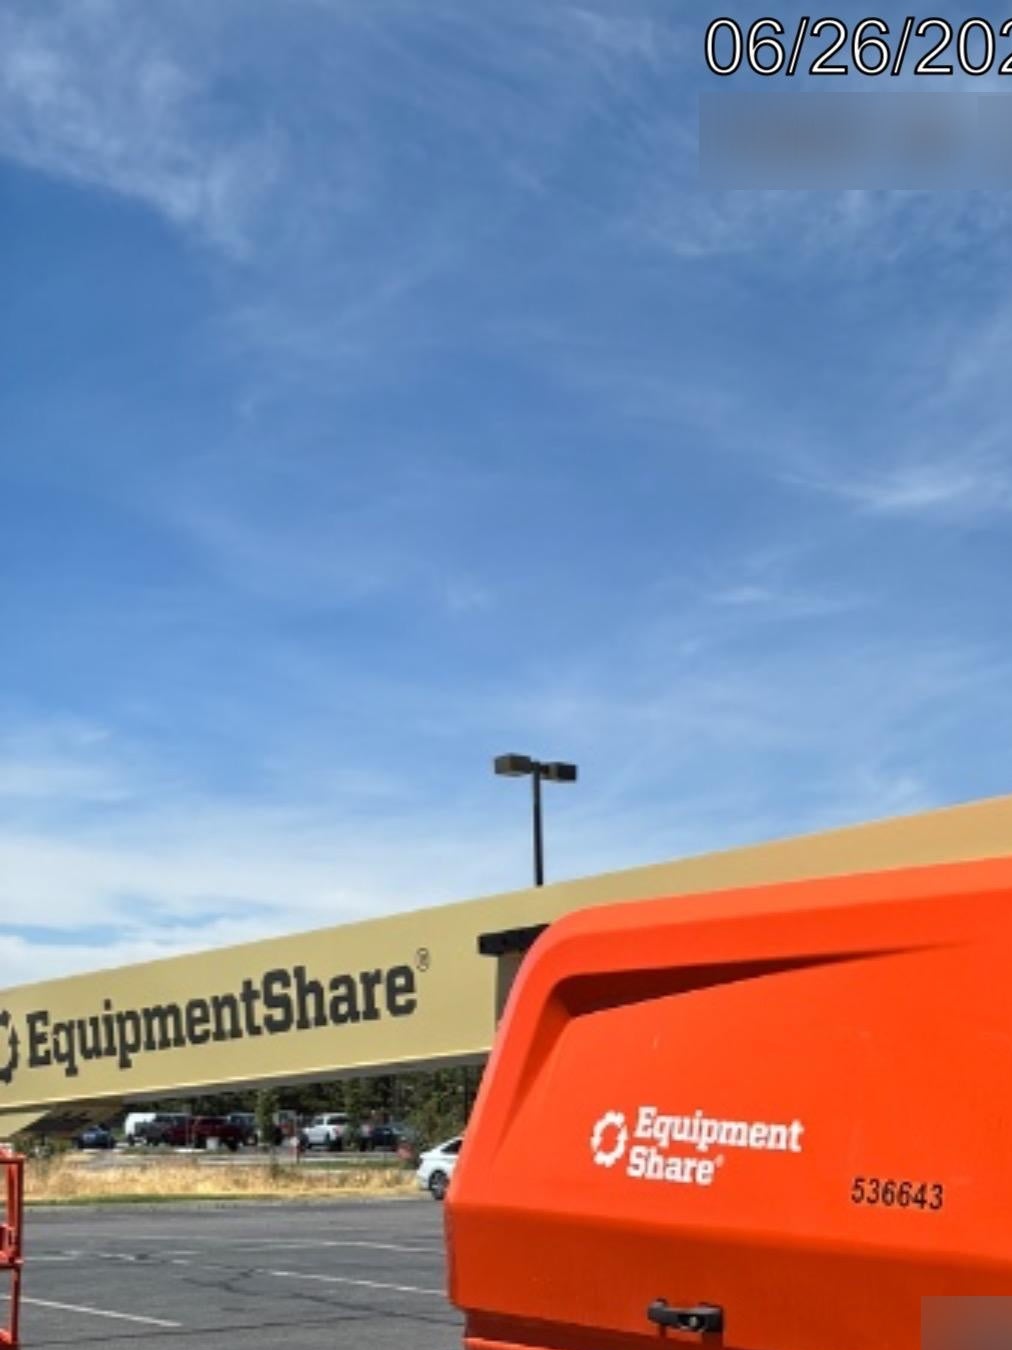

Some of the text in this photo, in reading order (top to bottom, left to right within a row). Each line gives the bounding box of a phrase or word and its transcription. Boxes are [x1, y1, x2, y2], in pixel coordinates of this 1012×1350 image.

[26, 965, 418, 1077] EquipmentShare
[635, 1106, 804, 1152] Equipment
[627, 1146, 715, 1185] Share
[851, 1177, 944, 1211] 536643
